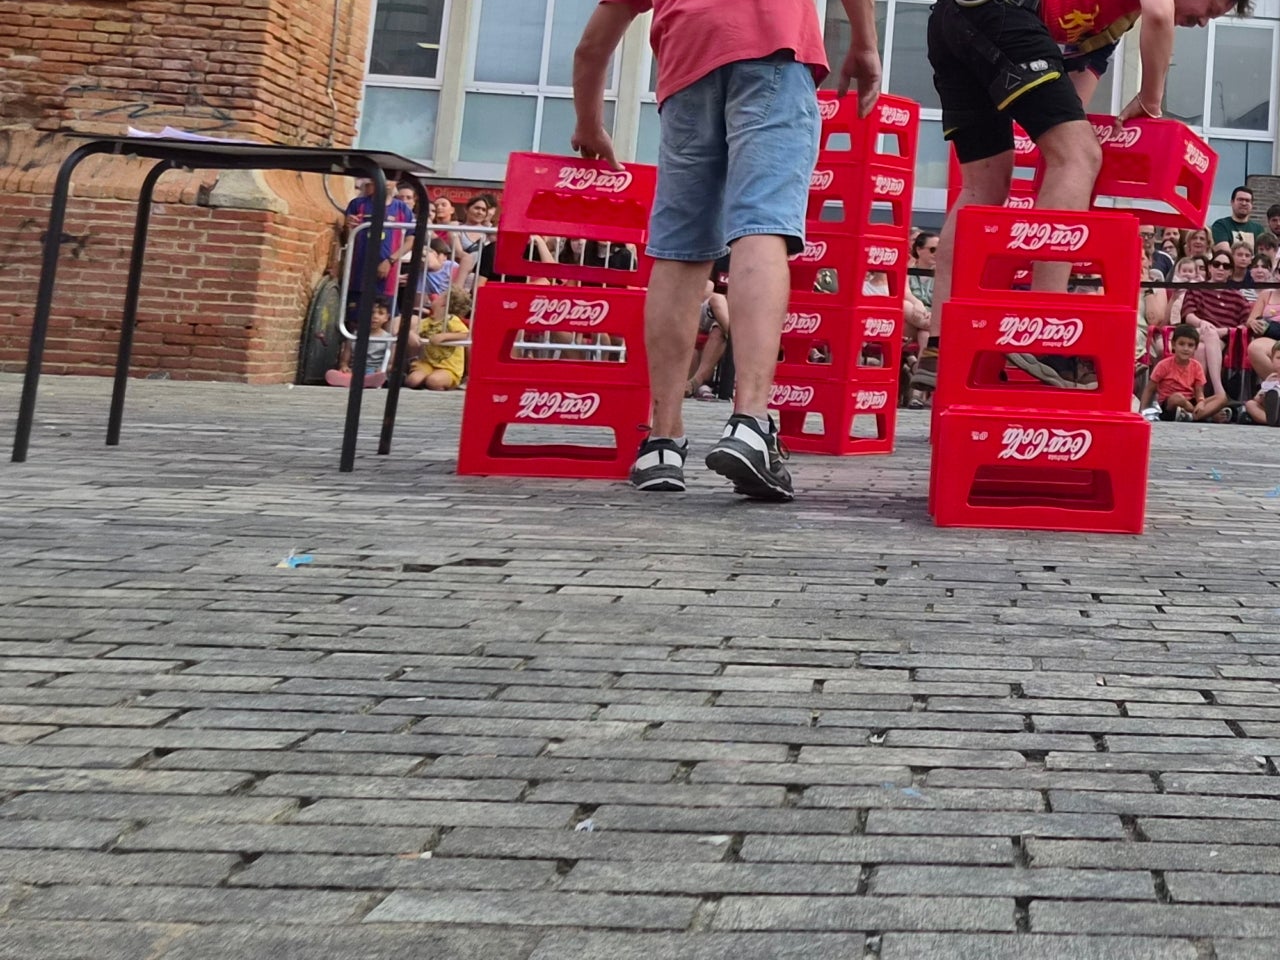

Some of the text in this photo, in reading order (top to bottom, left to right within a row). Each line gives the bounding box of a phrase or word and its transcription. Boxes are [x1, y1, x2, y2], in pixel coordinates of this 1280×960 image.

[555, 167, 632, 192] Coca-Cola
[1006, 223, 1089, 251] Coca-Cola
[526, 299, 609, 325] Coca-Cola
[996, 317, 1083, 346] Coca-Cola
[516, 392, 600, 419] Coca-Cola
[997, 428, 1092, 460] Coca-Cola
